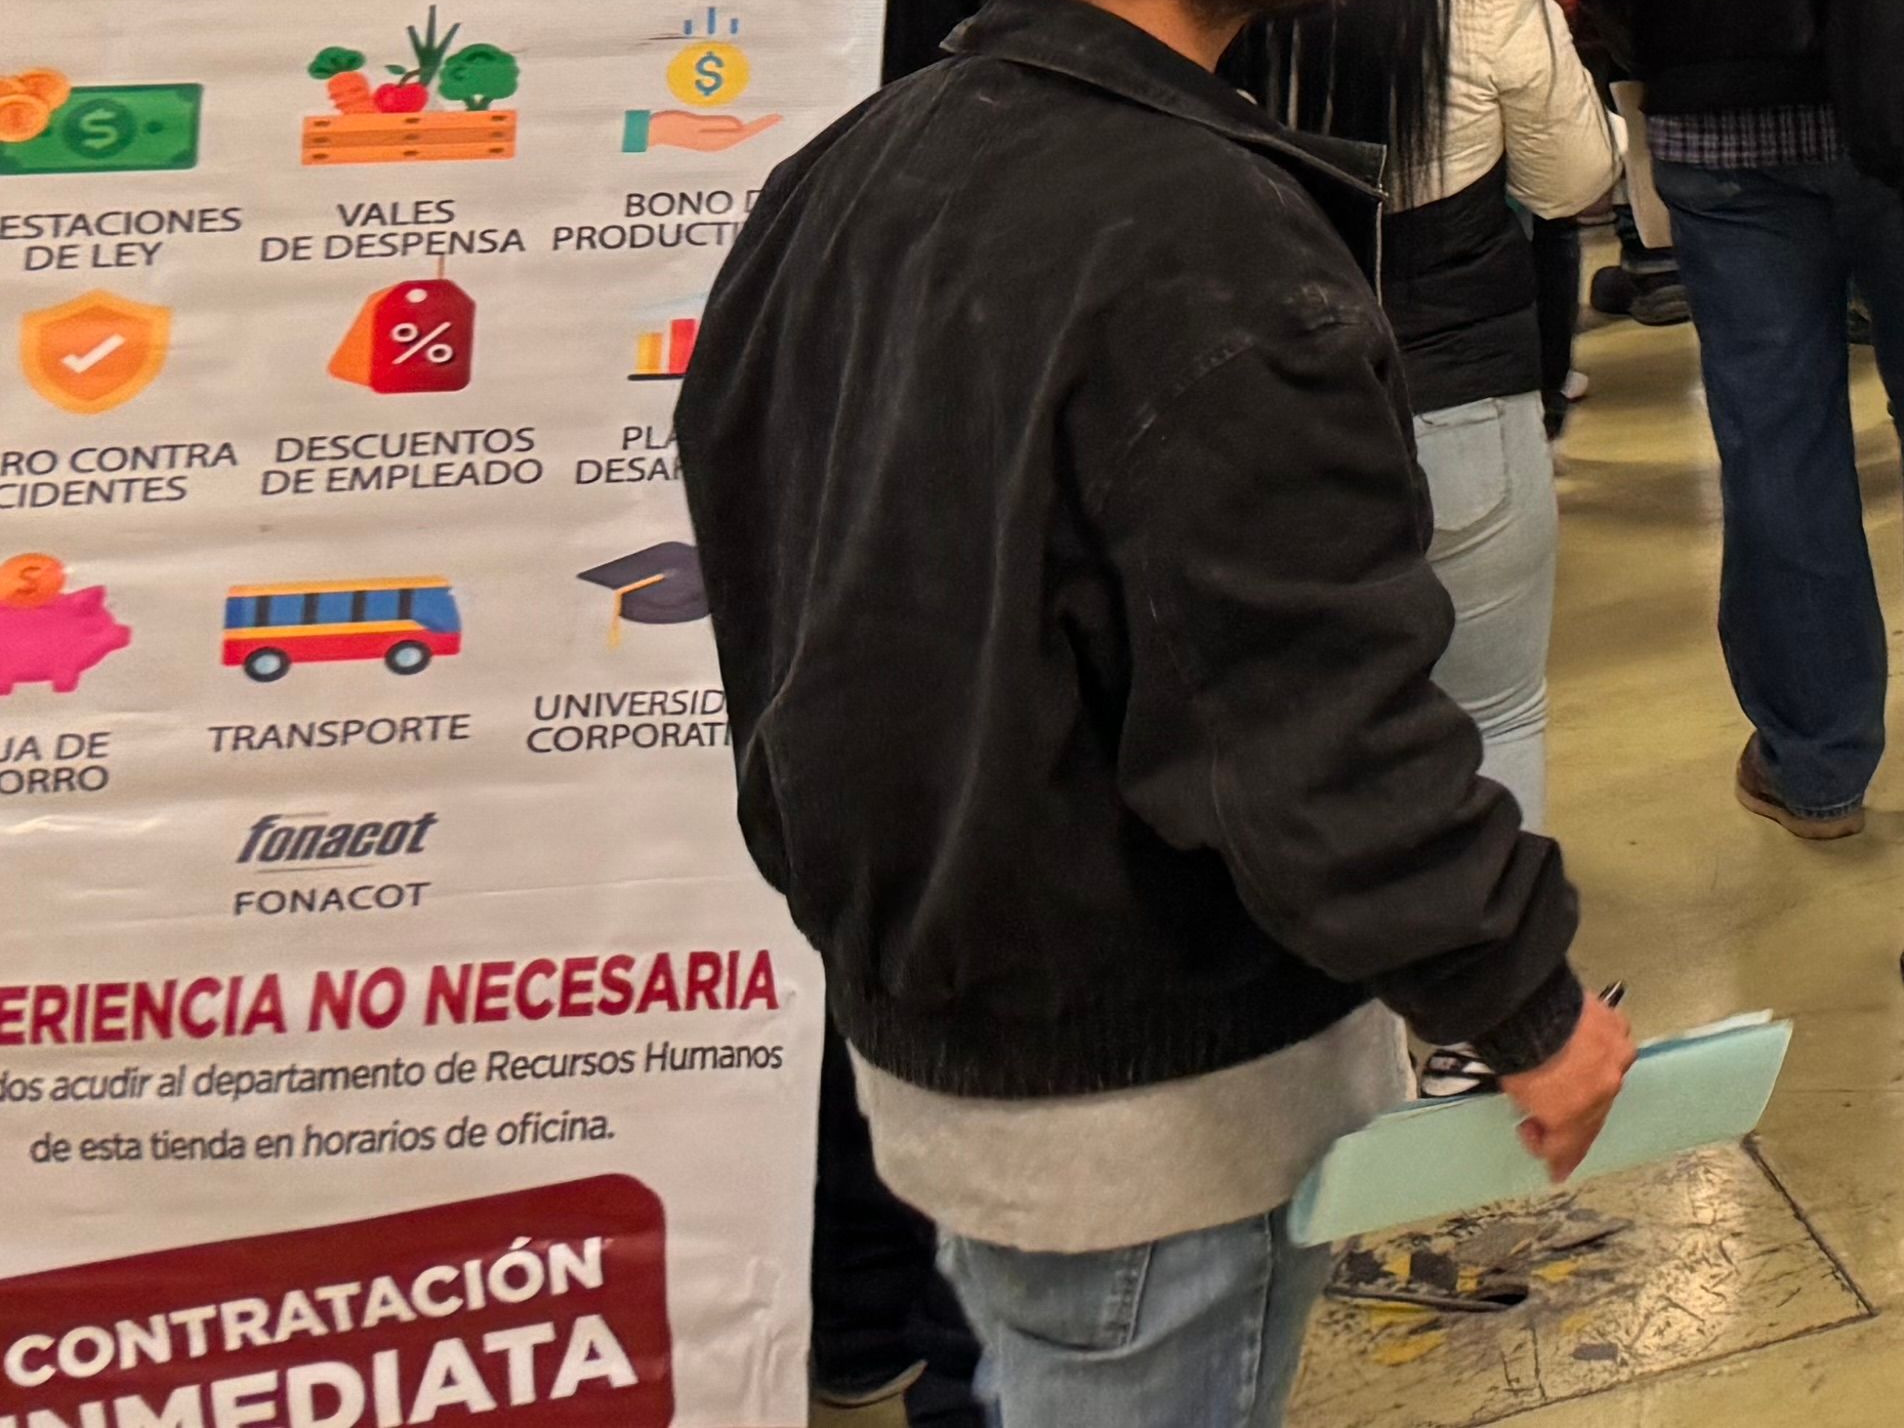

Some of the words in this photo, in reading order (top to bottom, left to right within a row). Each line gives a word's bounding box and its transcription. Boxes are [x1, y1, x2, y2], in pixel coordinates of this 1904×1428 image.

[337, 199, 456, 228] VALES
[624, 190, 733, 217] BONO
[24, 245, 79, 271] DE
[92, 242, 163, 268] LEY
[260, 235, 310, 263] DE
[323, 228, 527, 261] DESPENSA
[69, 442, 238, 473] CONTRA
[275, 427, 536, 465] DESCUENTOS
[261, 466, 317, 497] DE
[325, 458, 544, 493] EMPLEADO
[56, 732, 111, 759] DE
[208, 714, 471, 753] TRANSPORTE
[235, 811, 438, 865] fonacot
[233, 882, 430, 915] FONACOT
[309, 967, 406, 1033] NO
[424, 950, 779, 1026] NECESARIA
[51, 1067, 152, 1101] acudir
[158, 1064, 186, 1096] al
[193, 1058, 425, 1102] departamento
[434, 1052, 476, 1084] de
[486, 1049, 636, 1082] Recursos
[644, 1041, 784, 1073] Humanos
[30, 1132, 71, 1162] de
[80, 1133, 143, 1160] esta
[151, 1129, 246, 1160] tienda
[256, 1133, 293, 1158] en
[303, 1121, 435, 1158] horarios
[445, 1115, 486, 1148] de
[496, 1111, 615, 1147] oficina.
[4, 1236, 605, 1387] CONTRATACIÓN
